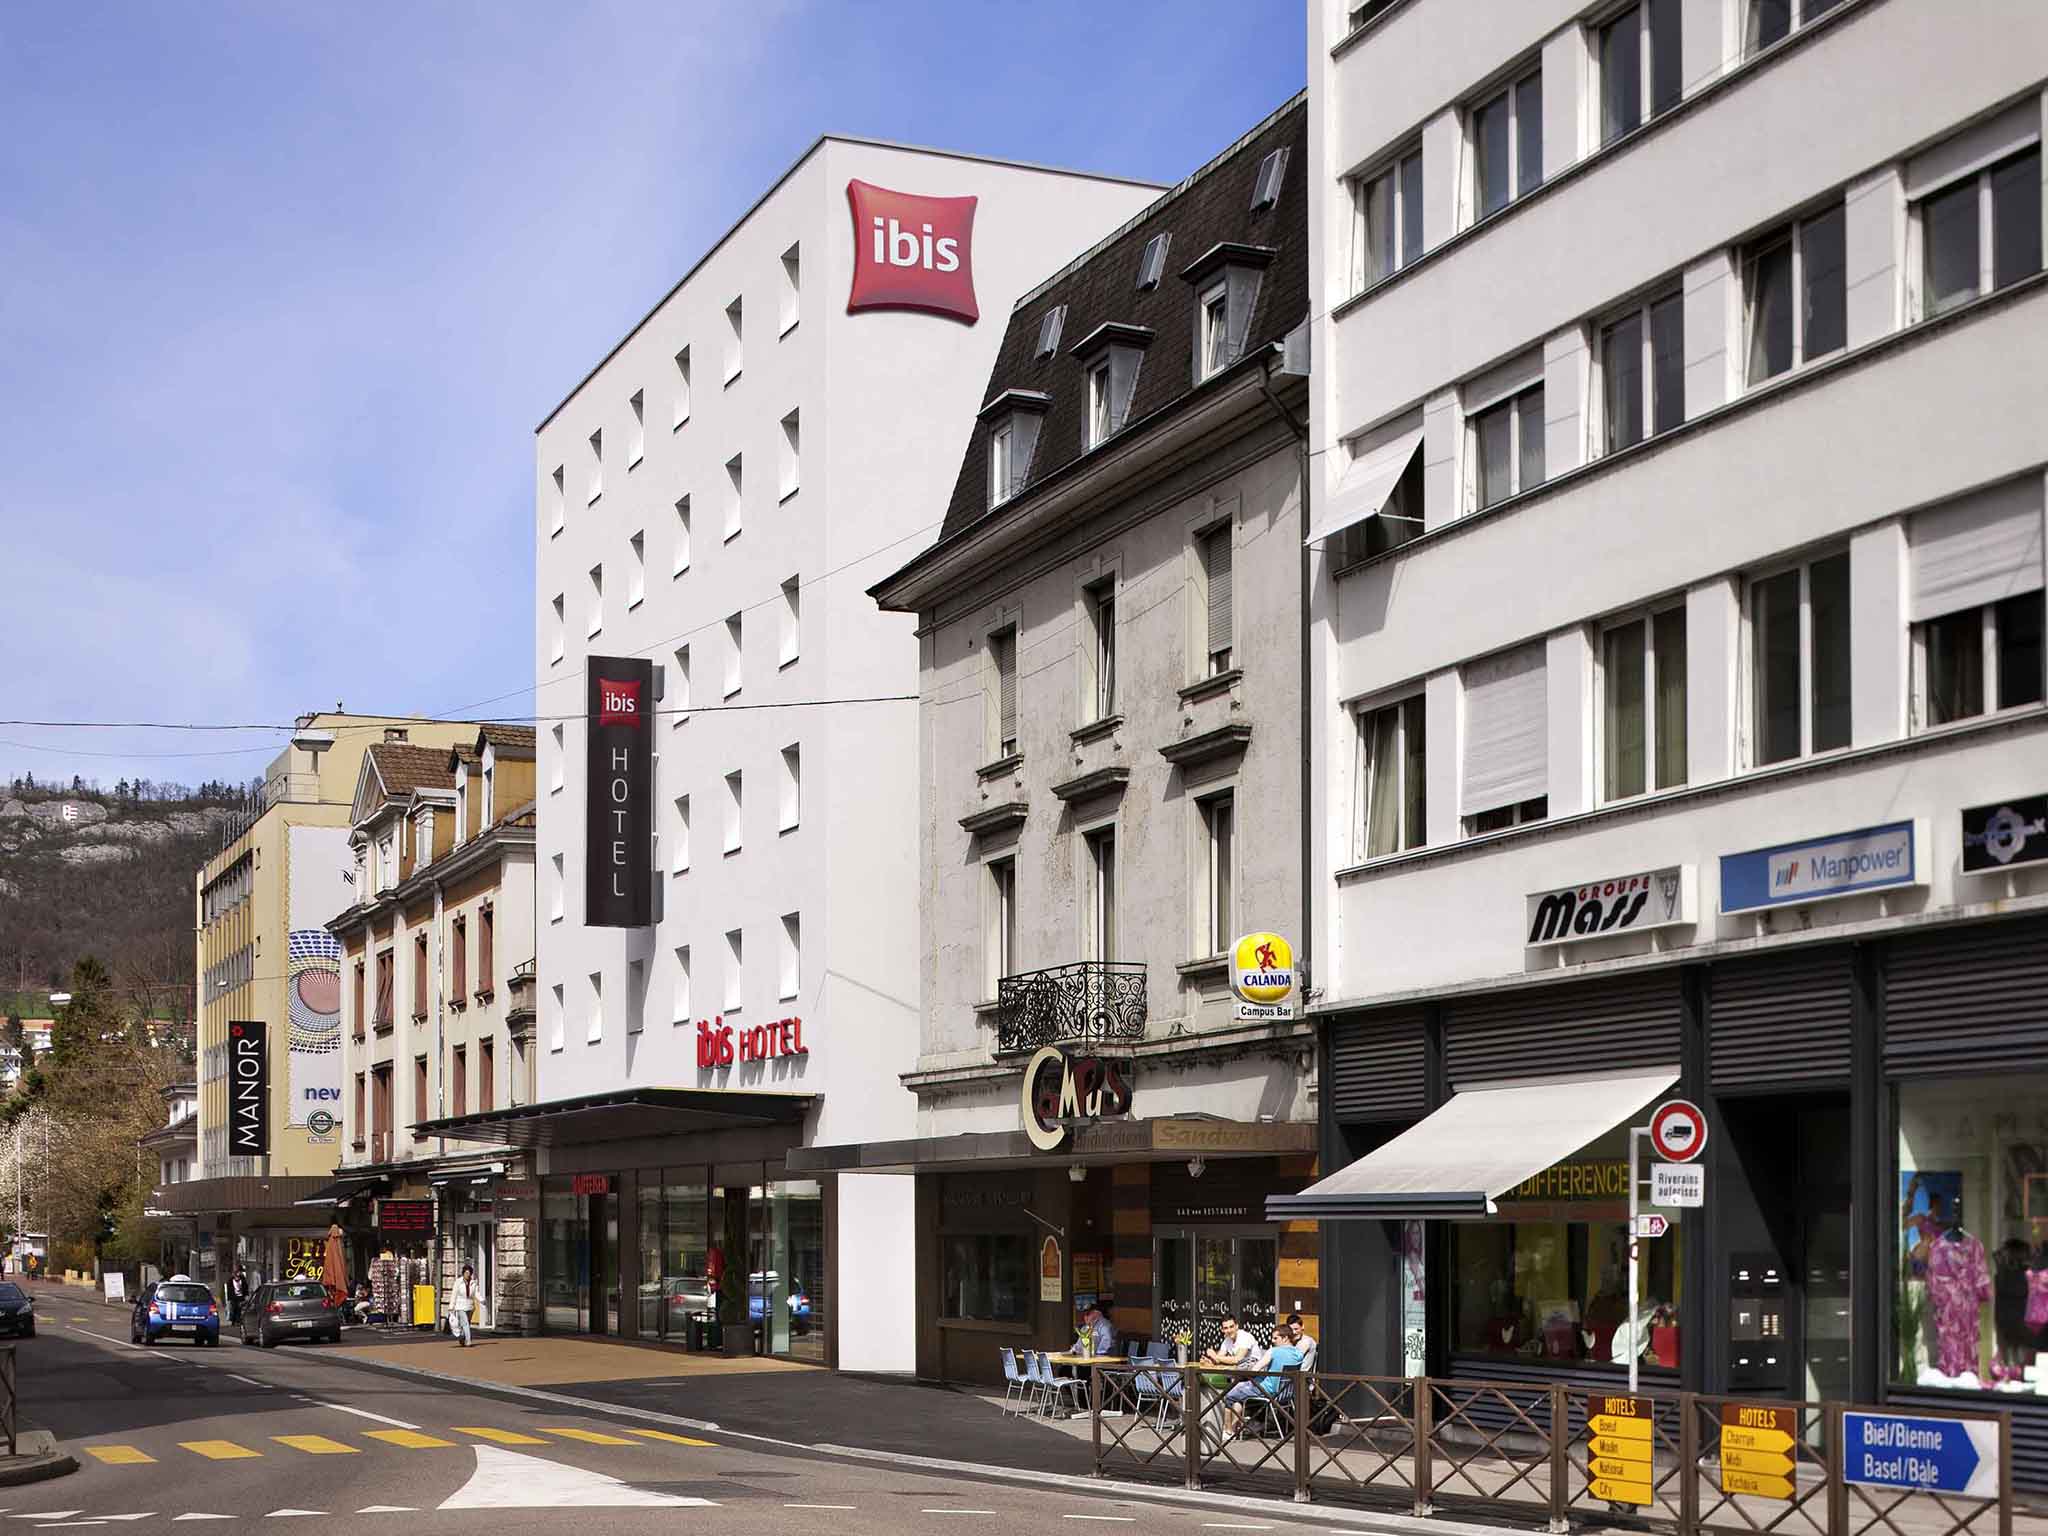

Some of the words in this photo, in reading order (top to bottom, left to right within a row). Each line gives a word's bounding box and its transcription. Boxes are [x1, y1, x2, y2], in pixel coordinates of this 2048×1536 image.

[873, 216, 960, 273] ibis
[605, 691, 636, 713] ibis
[611, 747, 629, 896] HOTEL
[1810, 845, 1904, 882] Manpower
[1578, 875, 1650, 902] GROUPE
[1243, 974, 1291, 986] CALANDA
[1240, 1005, 1275, 1018] Campus
[1277, 1006, 1291, 1016] Bar
[696, 1015, 735, 1068] ibis
[738, 1016, 809, 1062] HOTEL
[237, 1039, 260, 1148] MANOR
[1658, 1172, 1699, 1185] Riverains
[1604, 1397, 1636, 1416] HOTELS
[1739, 1407, 1777, 1429] HOTELS
[1863, 1420, 1943, 1451] Biel/Bienne
